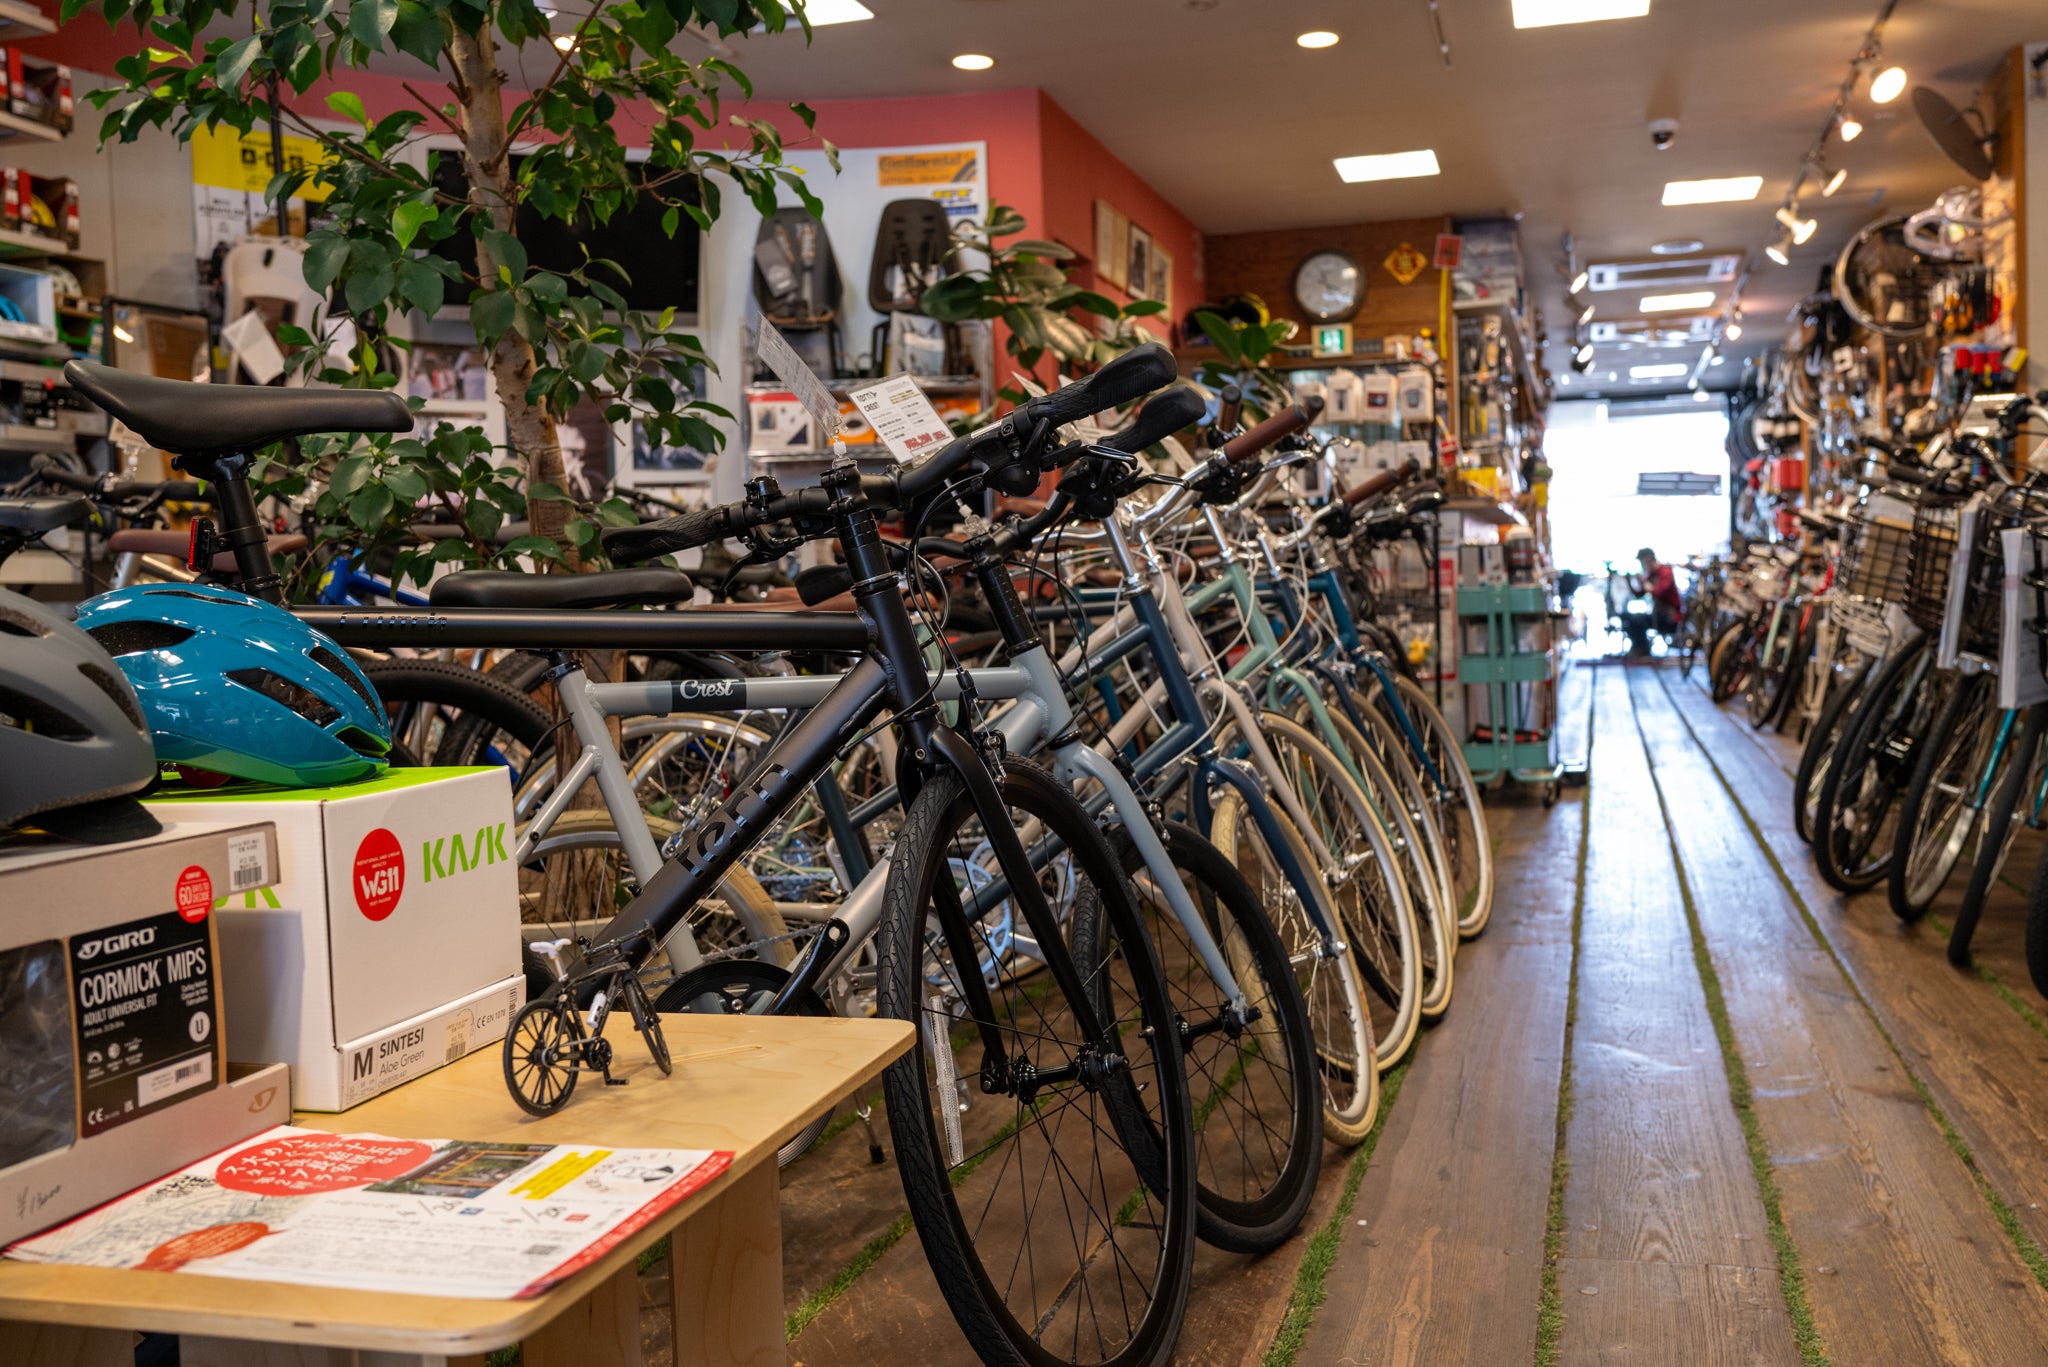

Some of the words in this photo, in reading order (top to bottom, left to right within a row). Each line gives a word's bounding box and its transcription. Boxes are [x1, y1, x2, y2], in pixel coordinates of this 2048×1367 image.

[680, 679, 739, 699] Crest
[422, 822, 508, 883] KASK
[179, 886, 192, 906] 60
[360, 866, 399, 900] WG11
[103, 928, 155, 955] GIRO
[79, 960, 161, 1008] CORMICK
[167, 946, 207, 983] MIPS
[83, 1008, 107, 1027] ADULT
[107, 997, 146, 1019] UNIVERSAL
[146, 993, 158, 1007] FIT
[486, 1014, 495, 1024] EN
[195, 1018, 204, 1034] U
[379, 1027, 424, 1059] SINTESI
[353, 1047, 374, 1081] M
[379, 1061, 399, 1077] Aloe
[400, 1050, 425, 1067] Green
